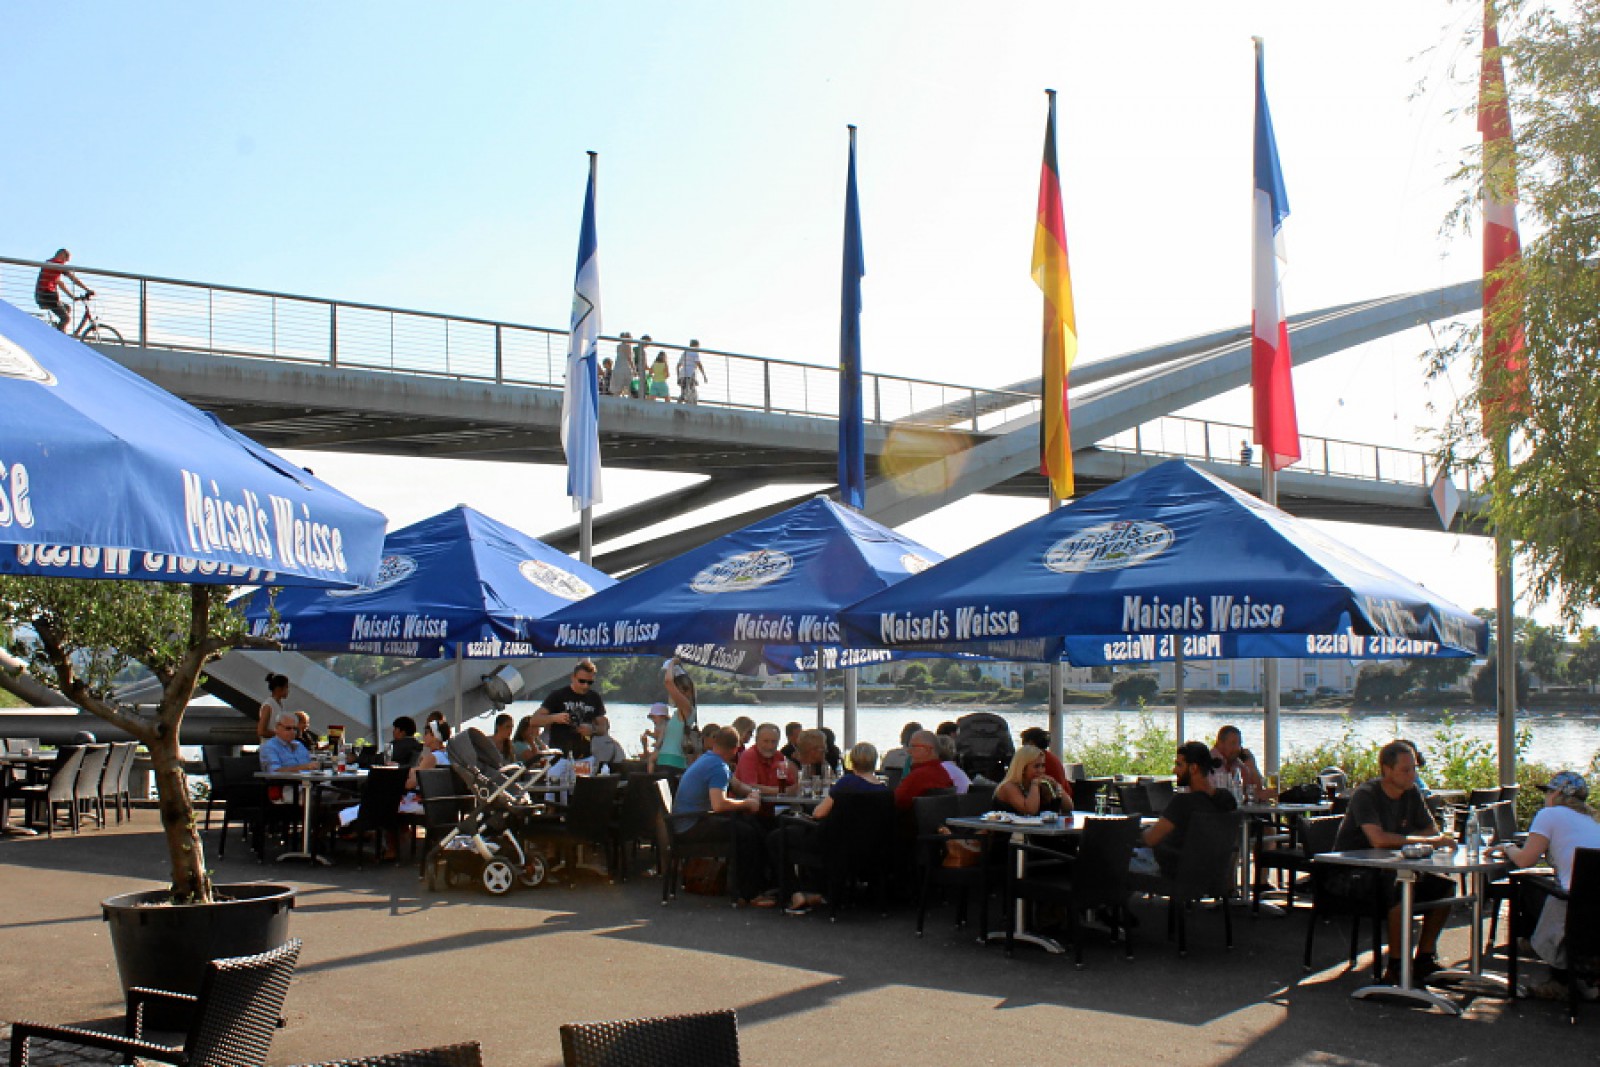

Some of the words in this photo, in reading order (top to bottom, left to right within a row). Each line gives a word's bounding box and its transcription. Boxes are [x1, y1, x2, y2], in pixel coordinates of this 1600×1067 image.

[181, 469, 273, 559] Maisel's
[269, 494, 348, 573] Weisse
[352, 613, 401, 641] Maisel's
[403, 613, 448, 640] Weisse
[734, 613, 794, 641] Maisel's
[798, 613, 840, 642] Weiss
[880, 608, 949, 644] Maisel's
[956, 604, 1020, 640] Weisse
[1122, 595, 1204, 632] Maisel's
[1211, 595, 1284, 632] Weisse
[554, 621, 610, 648] Maisel's
[613, 619, 660, 646] Weisse
